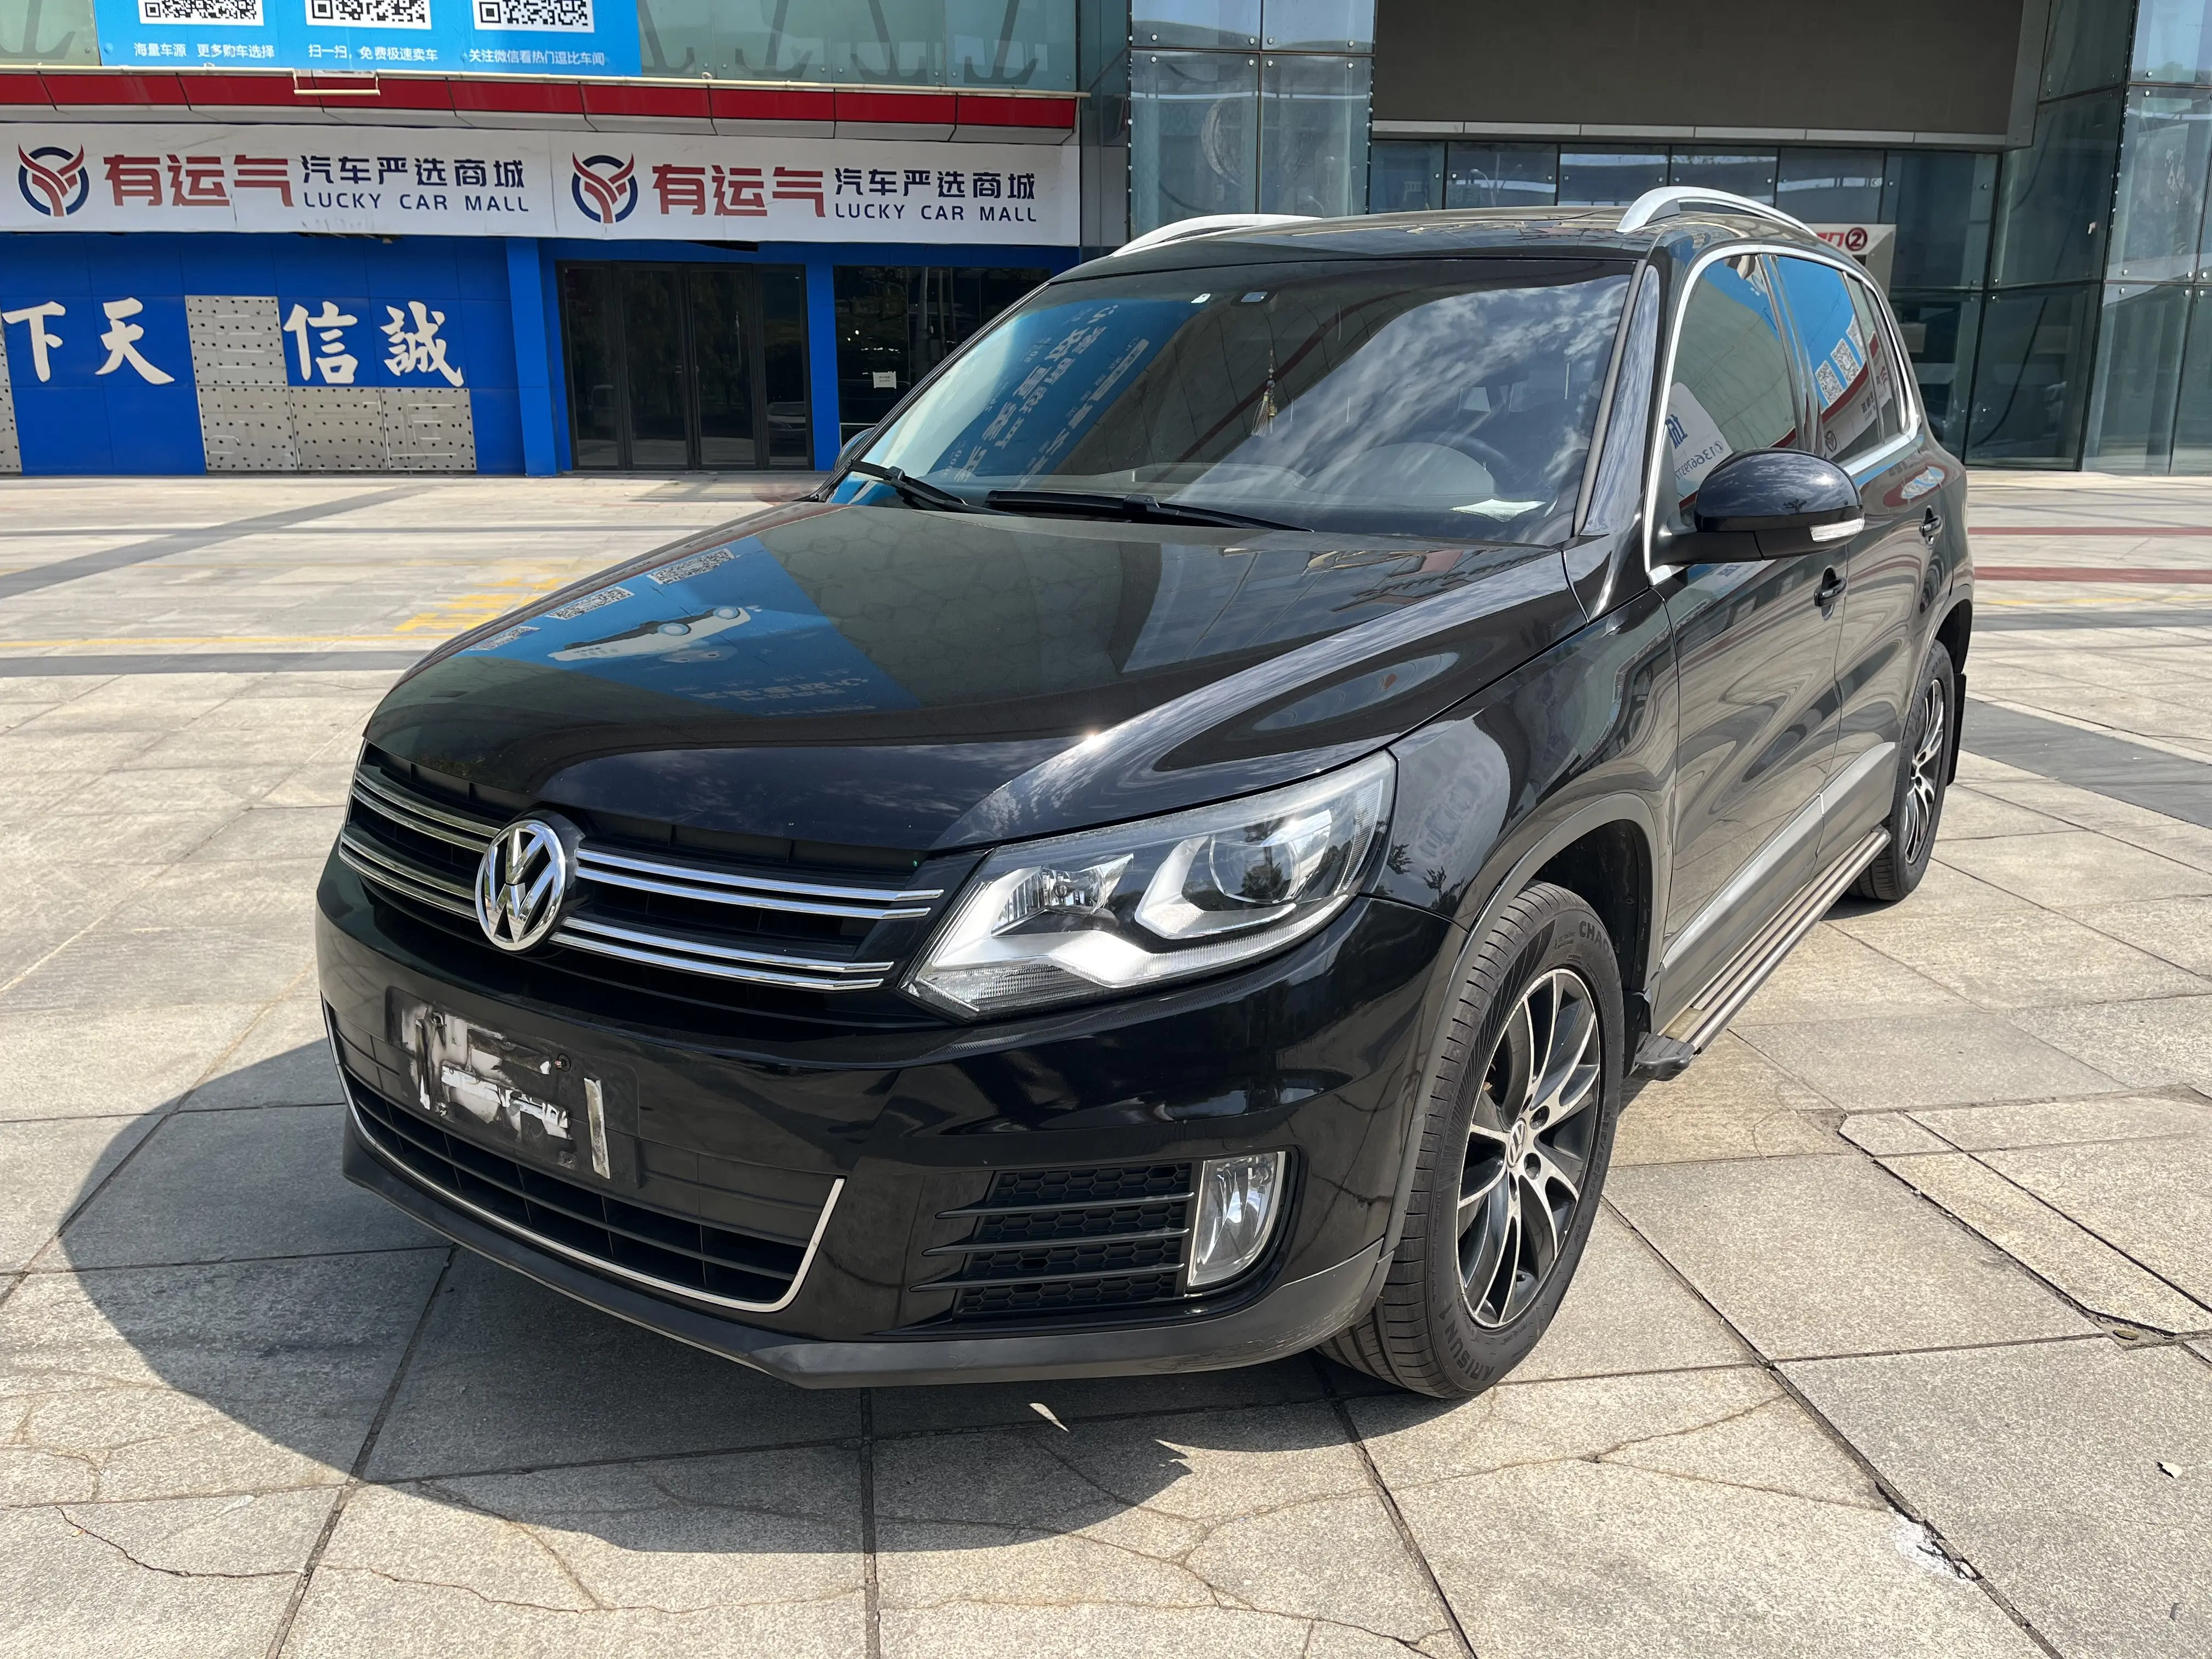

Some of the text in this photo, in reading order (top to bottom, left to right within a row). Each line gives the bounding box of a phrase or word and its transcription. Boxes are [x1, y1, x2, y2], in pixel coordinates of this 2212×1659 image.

[133, 42, 275, 59] 海量车源 更多购车选择
[469, 48, 605, 65] 关注微信看热门逗比车间
[103, 154, 295, 207] 有运气
[300, 155, 525, 188] 汽车严选商城
[834, 167, 1036, 200] 汽车严选商城
[304, 192, 529, 212] LUCKY CAR MALL
[651, 163, 826, 217] 有运气
[834, 203, 1037, 223] LUCKY CAR MALL
